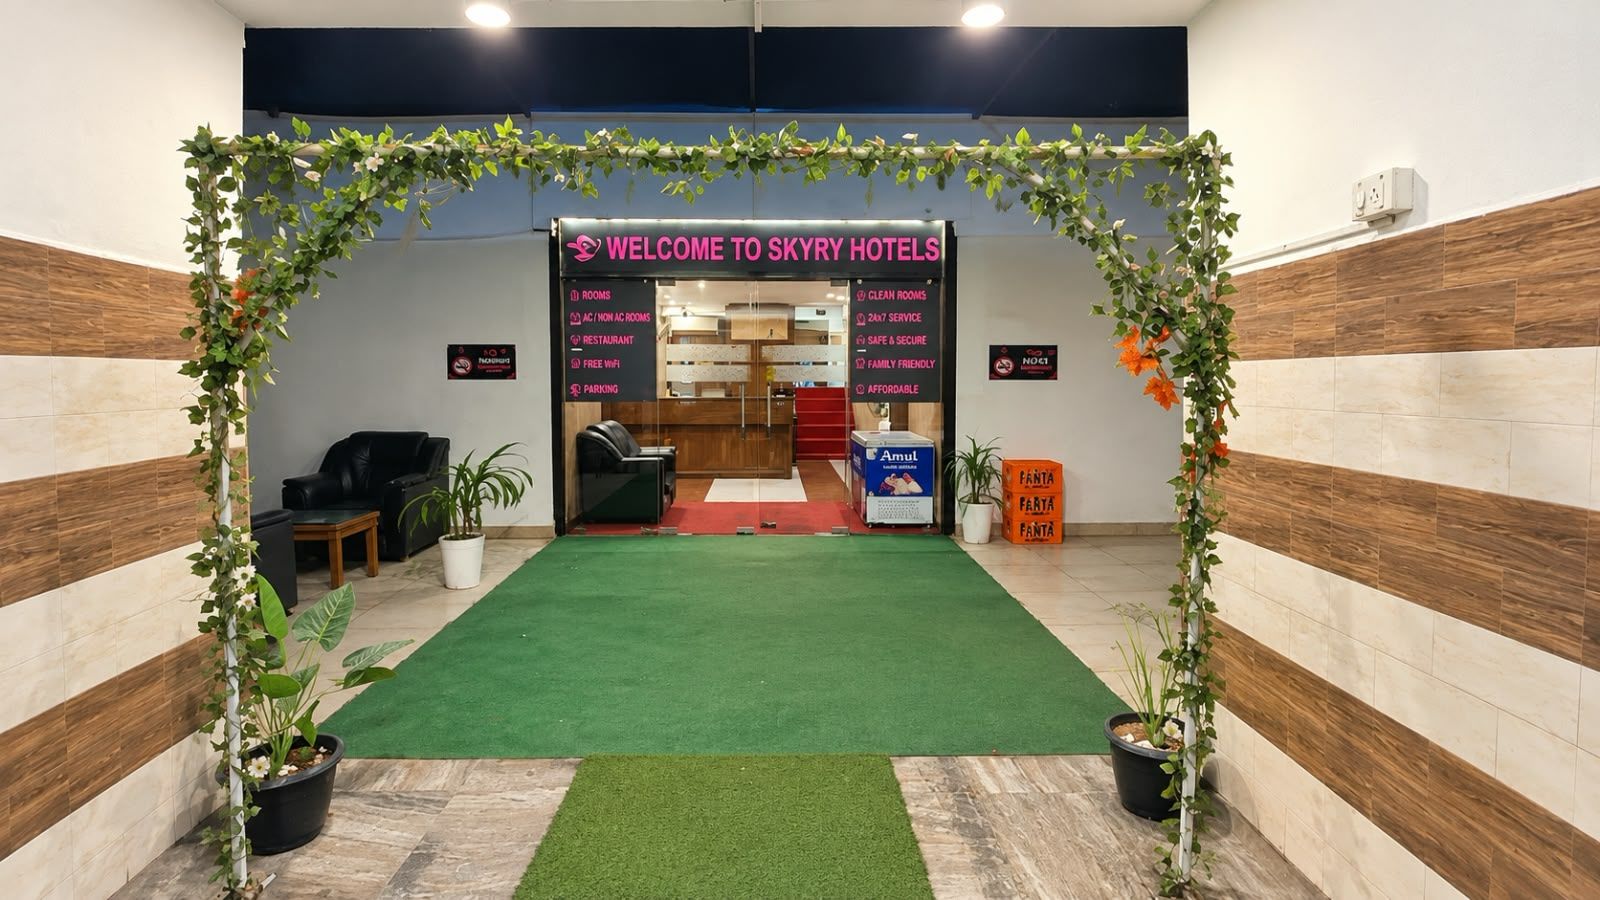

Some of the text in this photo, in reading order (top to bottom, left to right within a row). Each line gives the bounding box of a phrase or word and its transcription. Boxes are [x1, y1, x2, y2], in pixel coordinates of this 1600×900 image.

[606, 236, 940, 262] WELCOME TO SKYRY HOTELS
[582, 290, 611, 300] ROOMS
[868, 290, 927, 300] CLEAN ROOMS
[582, 312, 592, 322] AC
[615, 313, 624, 322] AC
[626, 313, 650, 322] ROOMS
[868, 313, 922, 322] 24x7 SERVICE
[583, 336, 634, 344] RESTAURANT
[868, 336, 927, 345] SAFE & SECURE
[583, 359, 603, 368] FREE
[868, 360, 936, 368] FAMILY FRIENDLY
[583, 384, 619, 394] PARKING
[868, 384, 919, 394] AFFORDABLE
[880, 450, 918, 461] Amul
[1020, 469, 1054, 484] FANTA
